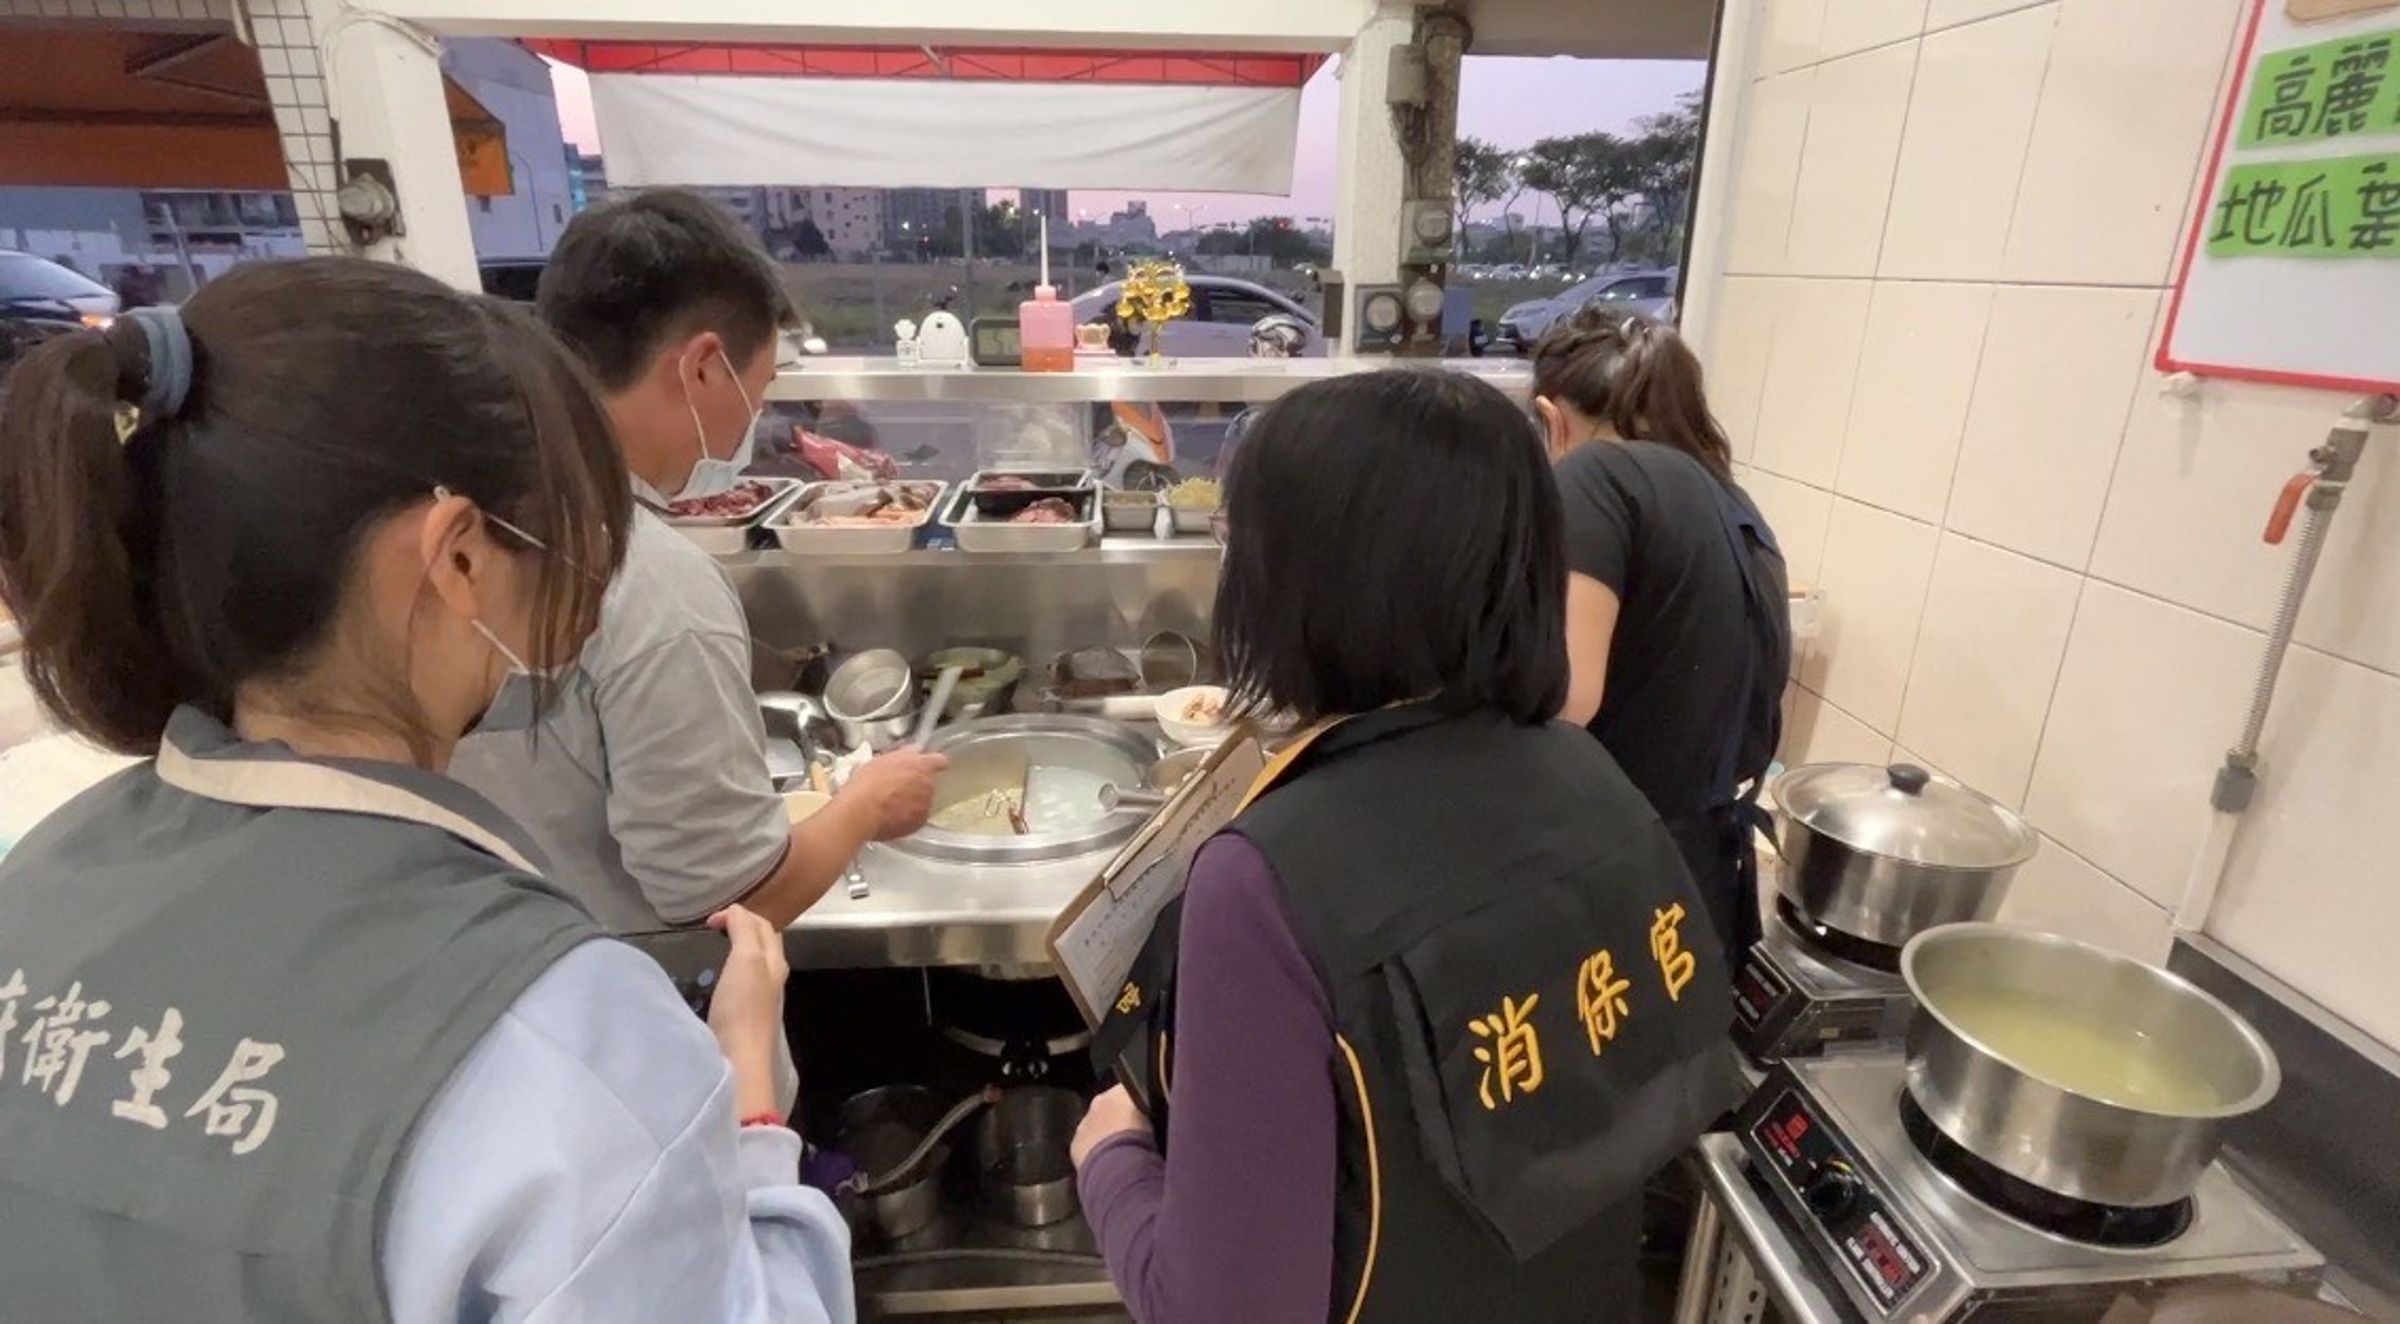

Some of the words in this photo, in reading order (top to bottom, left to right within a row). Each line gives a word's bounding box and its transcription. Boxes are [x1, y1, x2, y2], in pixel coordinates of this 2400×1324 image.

[2256, 38, 2400, 141] 高麗
[2209, 162, 2400, 250] 地瓜葉
[1468, 902, 1696, 1110] 消保官
